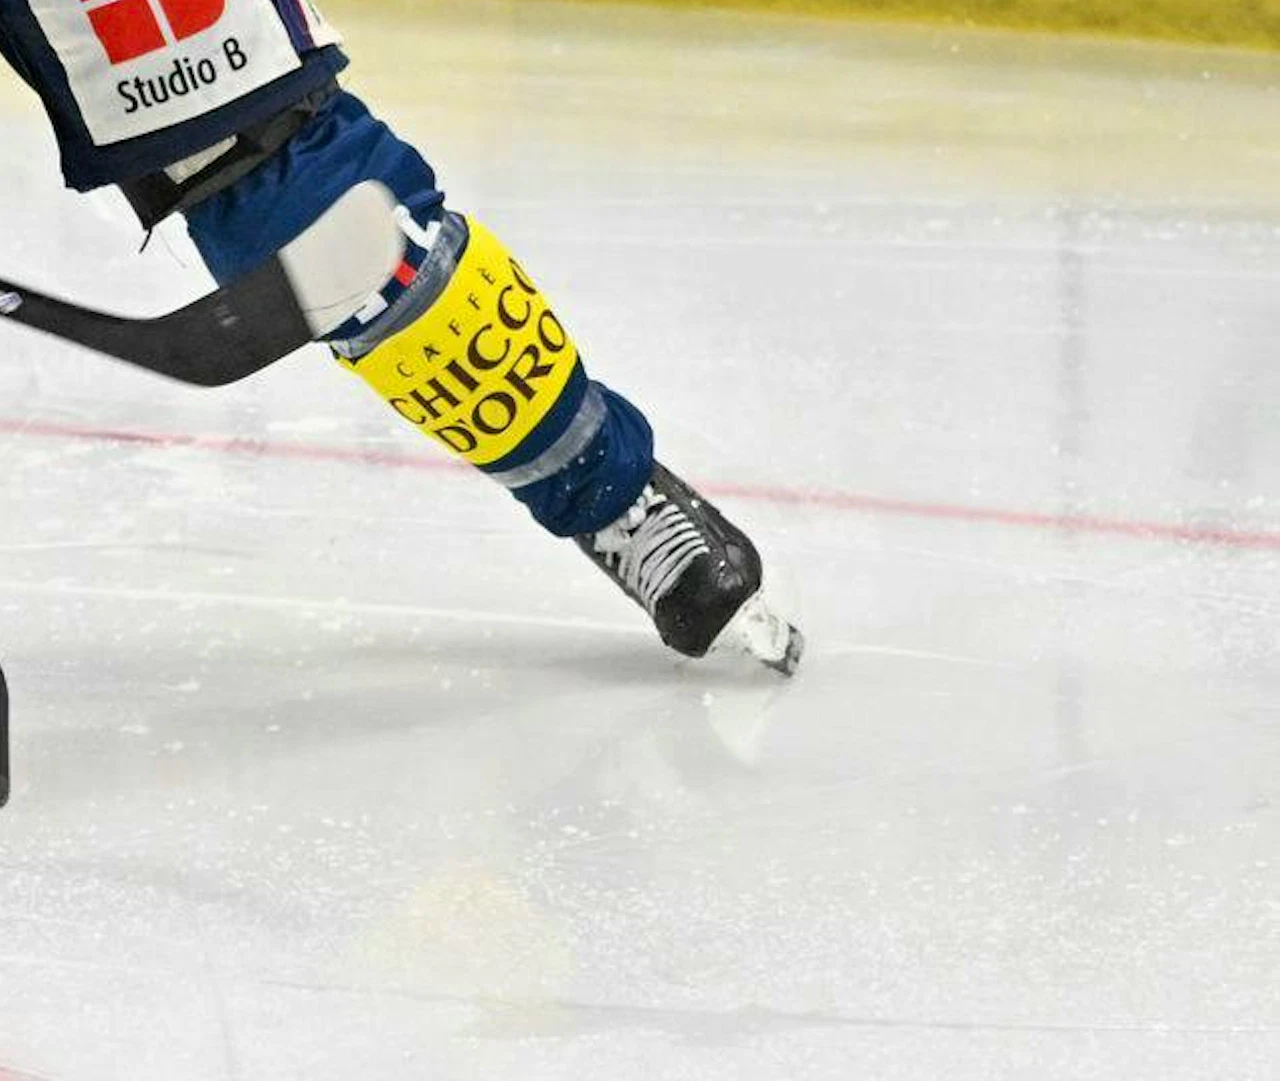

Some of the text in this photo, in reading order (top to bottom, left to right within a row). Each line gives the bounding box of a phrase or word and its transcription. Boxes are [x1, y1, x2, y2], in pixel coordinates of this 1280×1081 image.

[116, 37, 248, 114] Studio B
[433, 308, 567, 454] D'ORO
